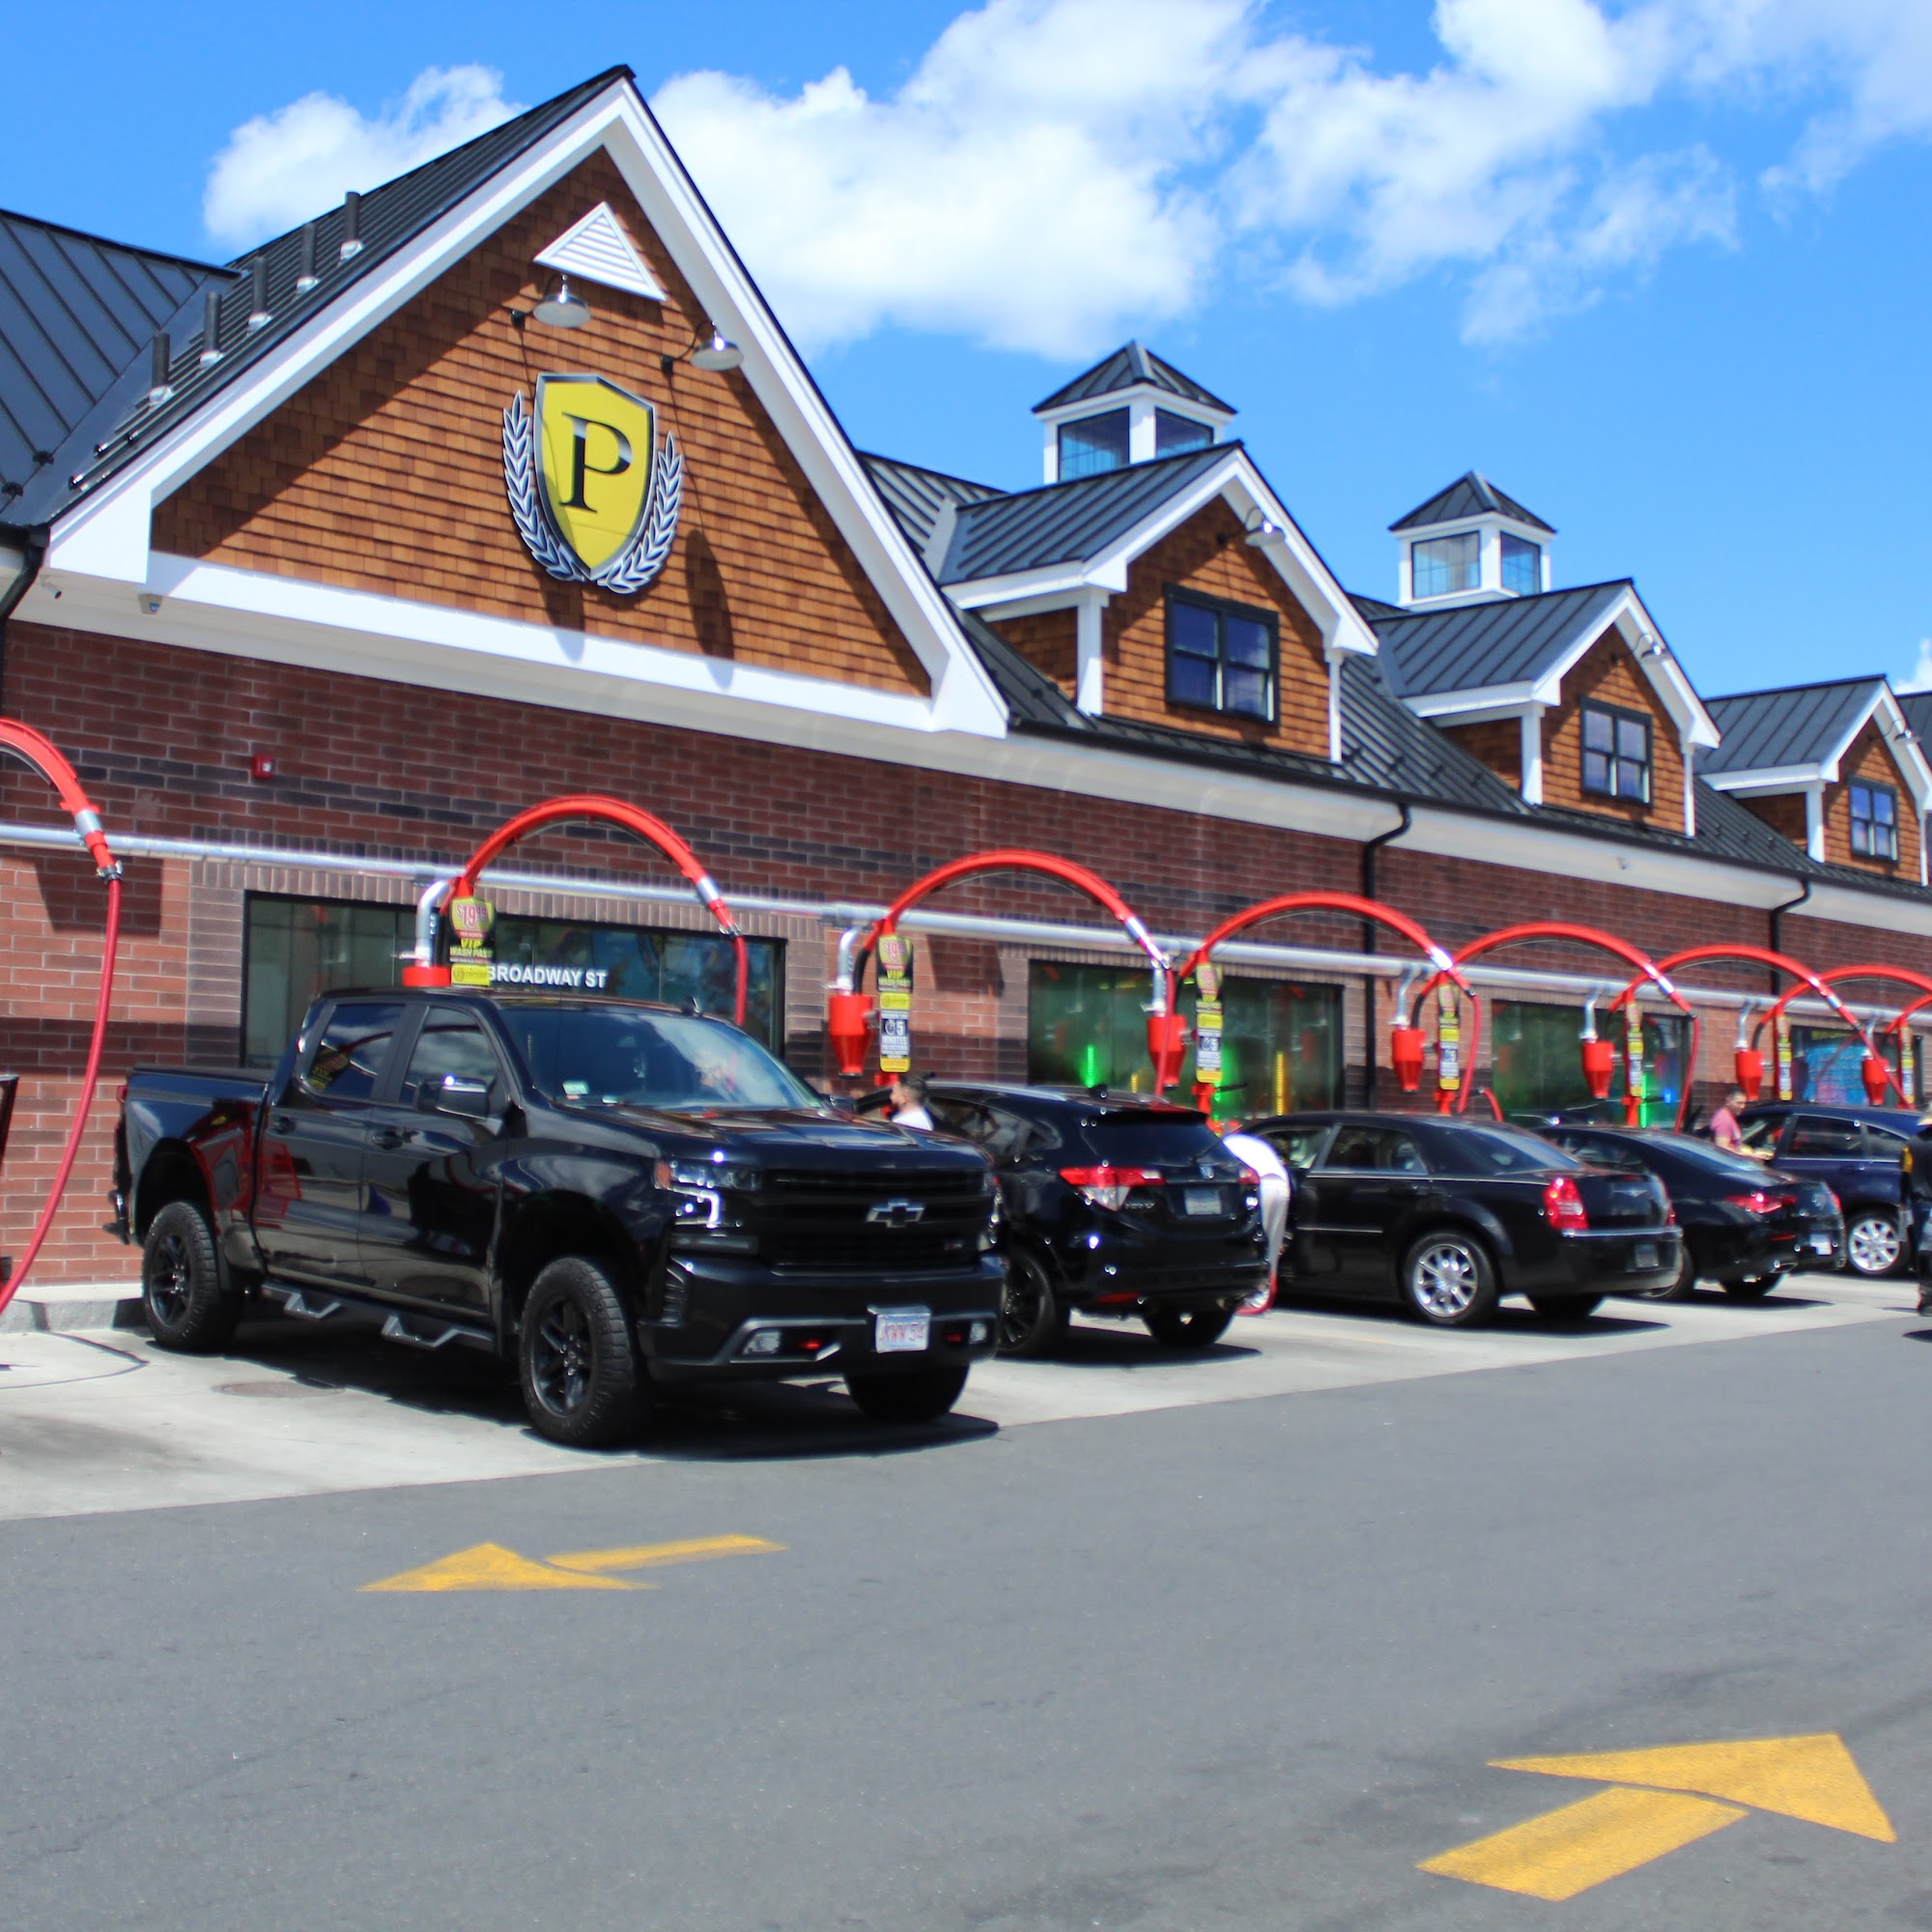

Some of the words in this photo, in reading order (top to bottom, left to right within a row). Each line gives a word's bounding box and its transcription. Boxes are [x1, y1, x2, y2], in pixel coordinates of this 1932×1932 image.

[558, 411, 633, 514] P
[450, 946, 472, 957] WASH
[461, 938, 483, 949] VIP
[487, 964, 582, 986] BROADWAY
[584, 968, 608, 988] ST
